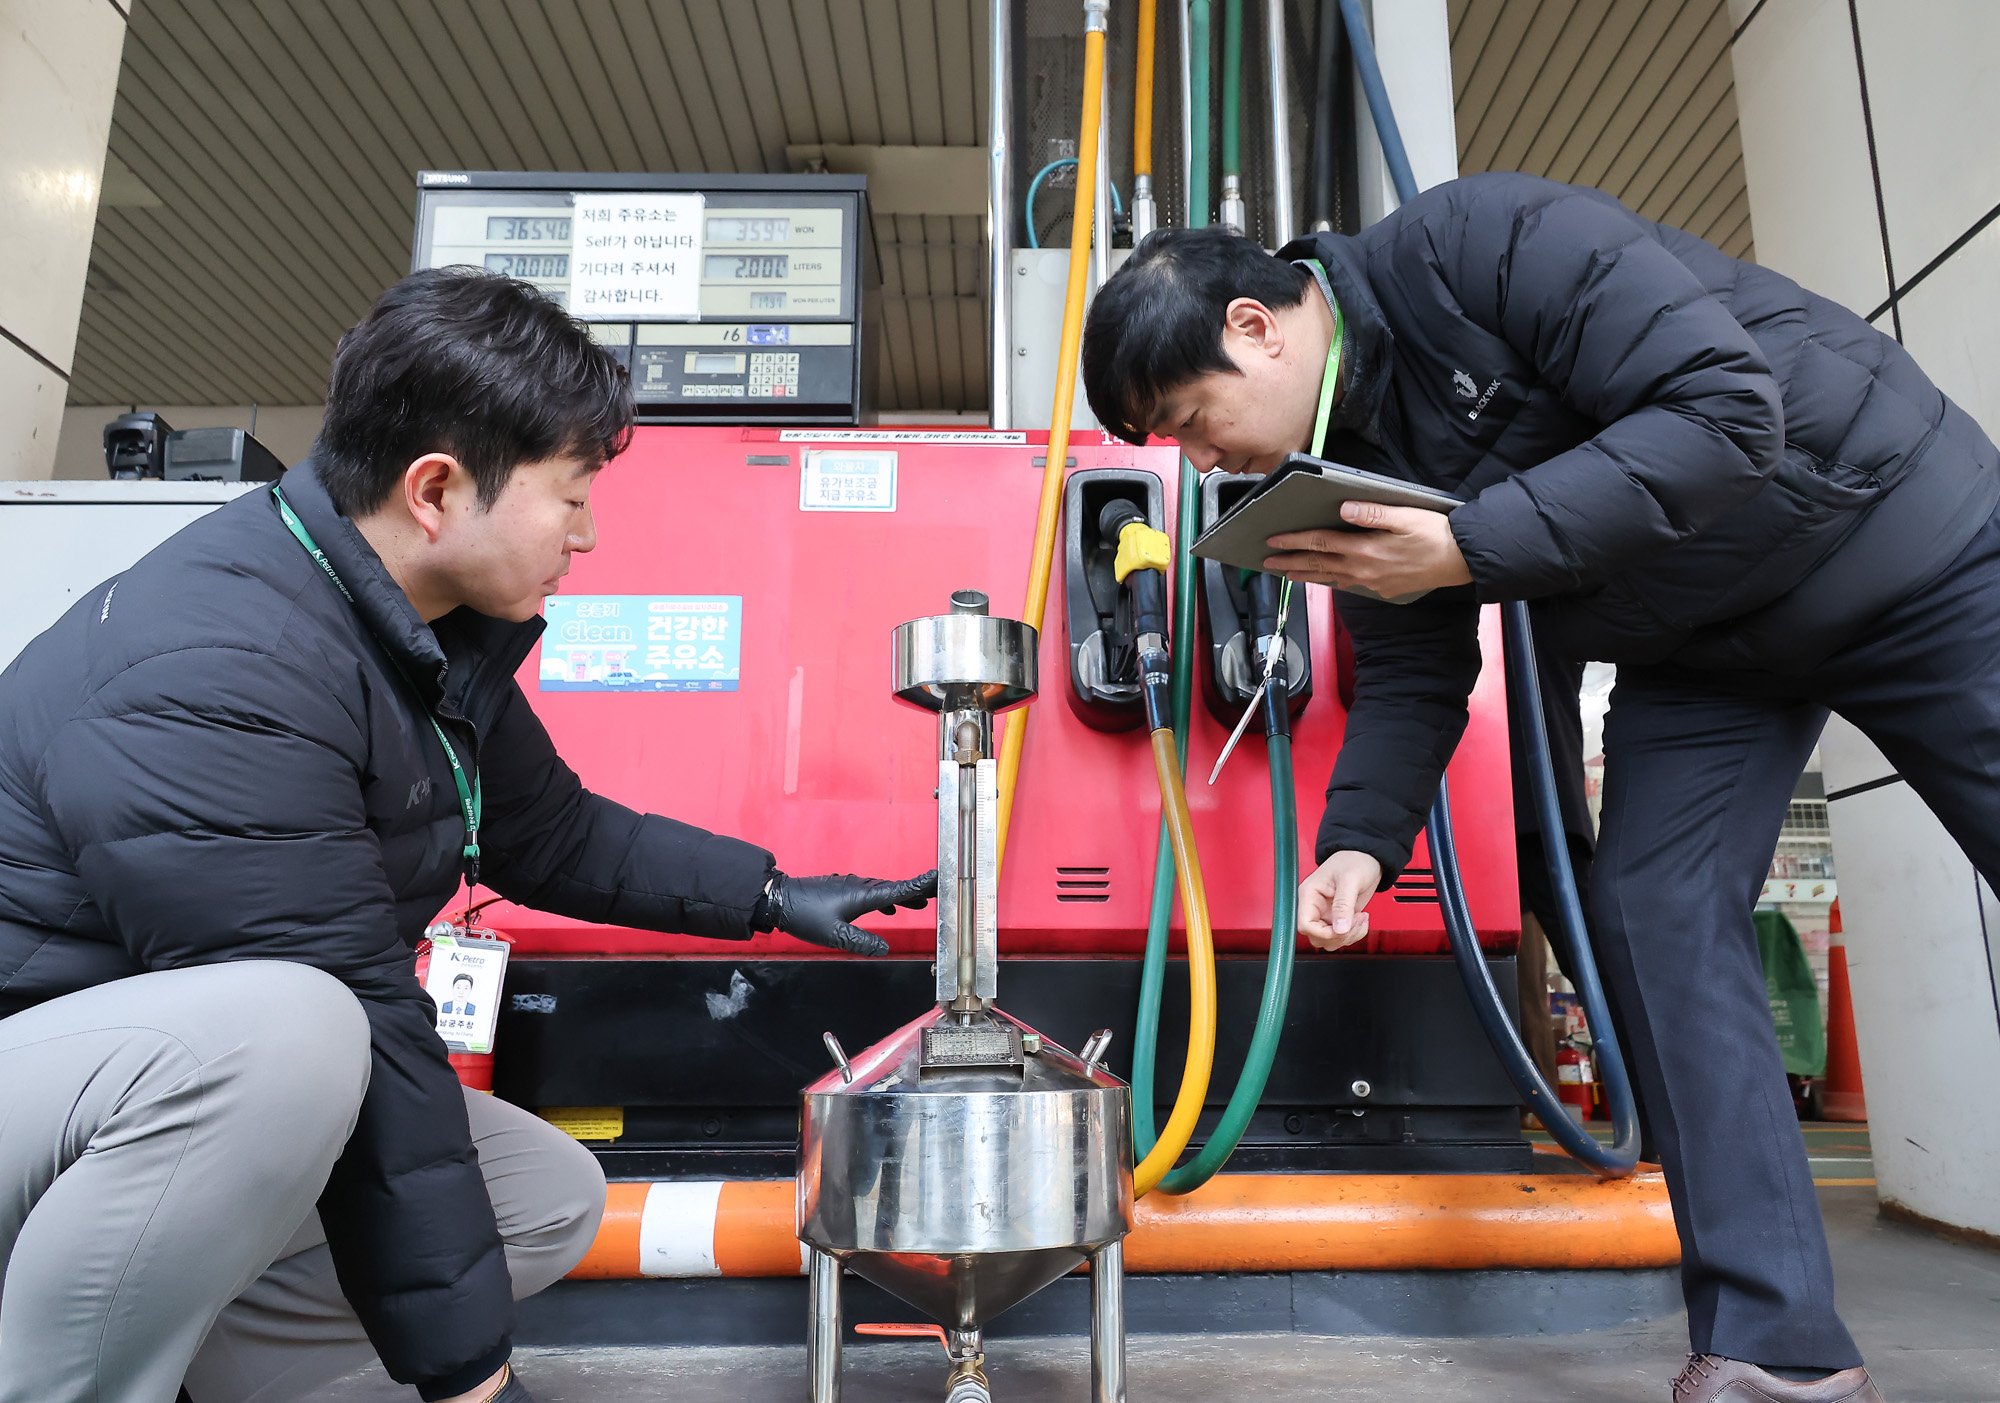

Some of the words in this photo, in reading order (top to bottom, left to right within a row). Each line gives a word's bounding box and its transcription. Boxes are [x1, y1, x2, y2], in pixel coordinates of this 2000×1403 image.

[582, 208, 611, 222] 저희
[618, 208, 677, 222] 주유소는
[794, 225, 815, 234] WON
[585, 234, 627, 249] Self가
[580, 262, 624, 276] 기다려
[631, 262, 676, 276] 주셔서
[793, 262, 823, 271] LITERS
[584, 288, 664, 303] 감사합니다.
[723, 327, 740, 342] 16
[820, 476, 877, 489] 유가보조금
[820, 489, 841, 501] 지급
[844, 489, 877, 501] 주유소
[319, 558, 336, 577] Petro
[560, 619, 633, 643] Clean
[647, 615, 729, 642] 건강한
[645, 644, 725, 670] 주유소
[462, 954, 485, 965] Petro
